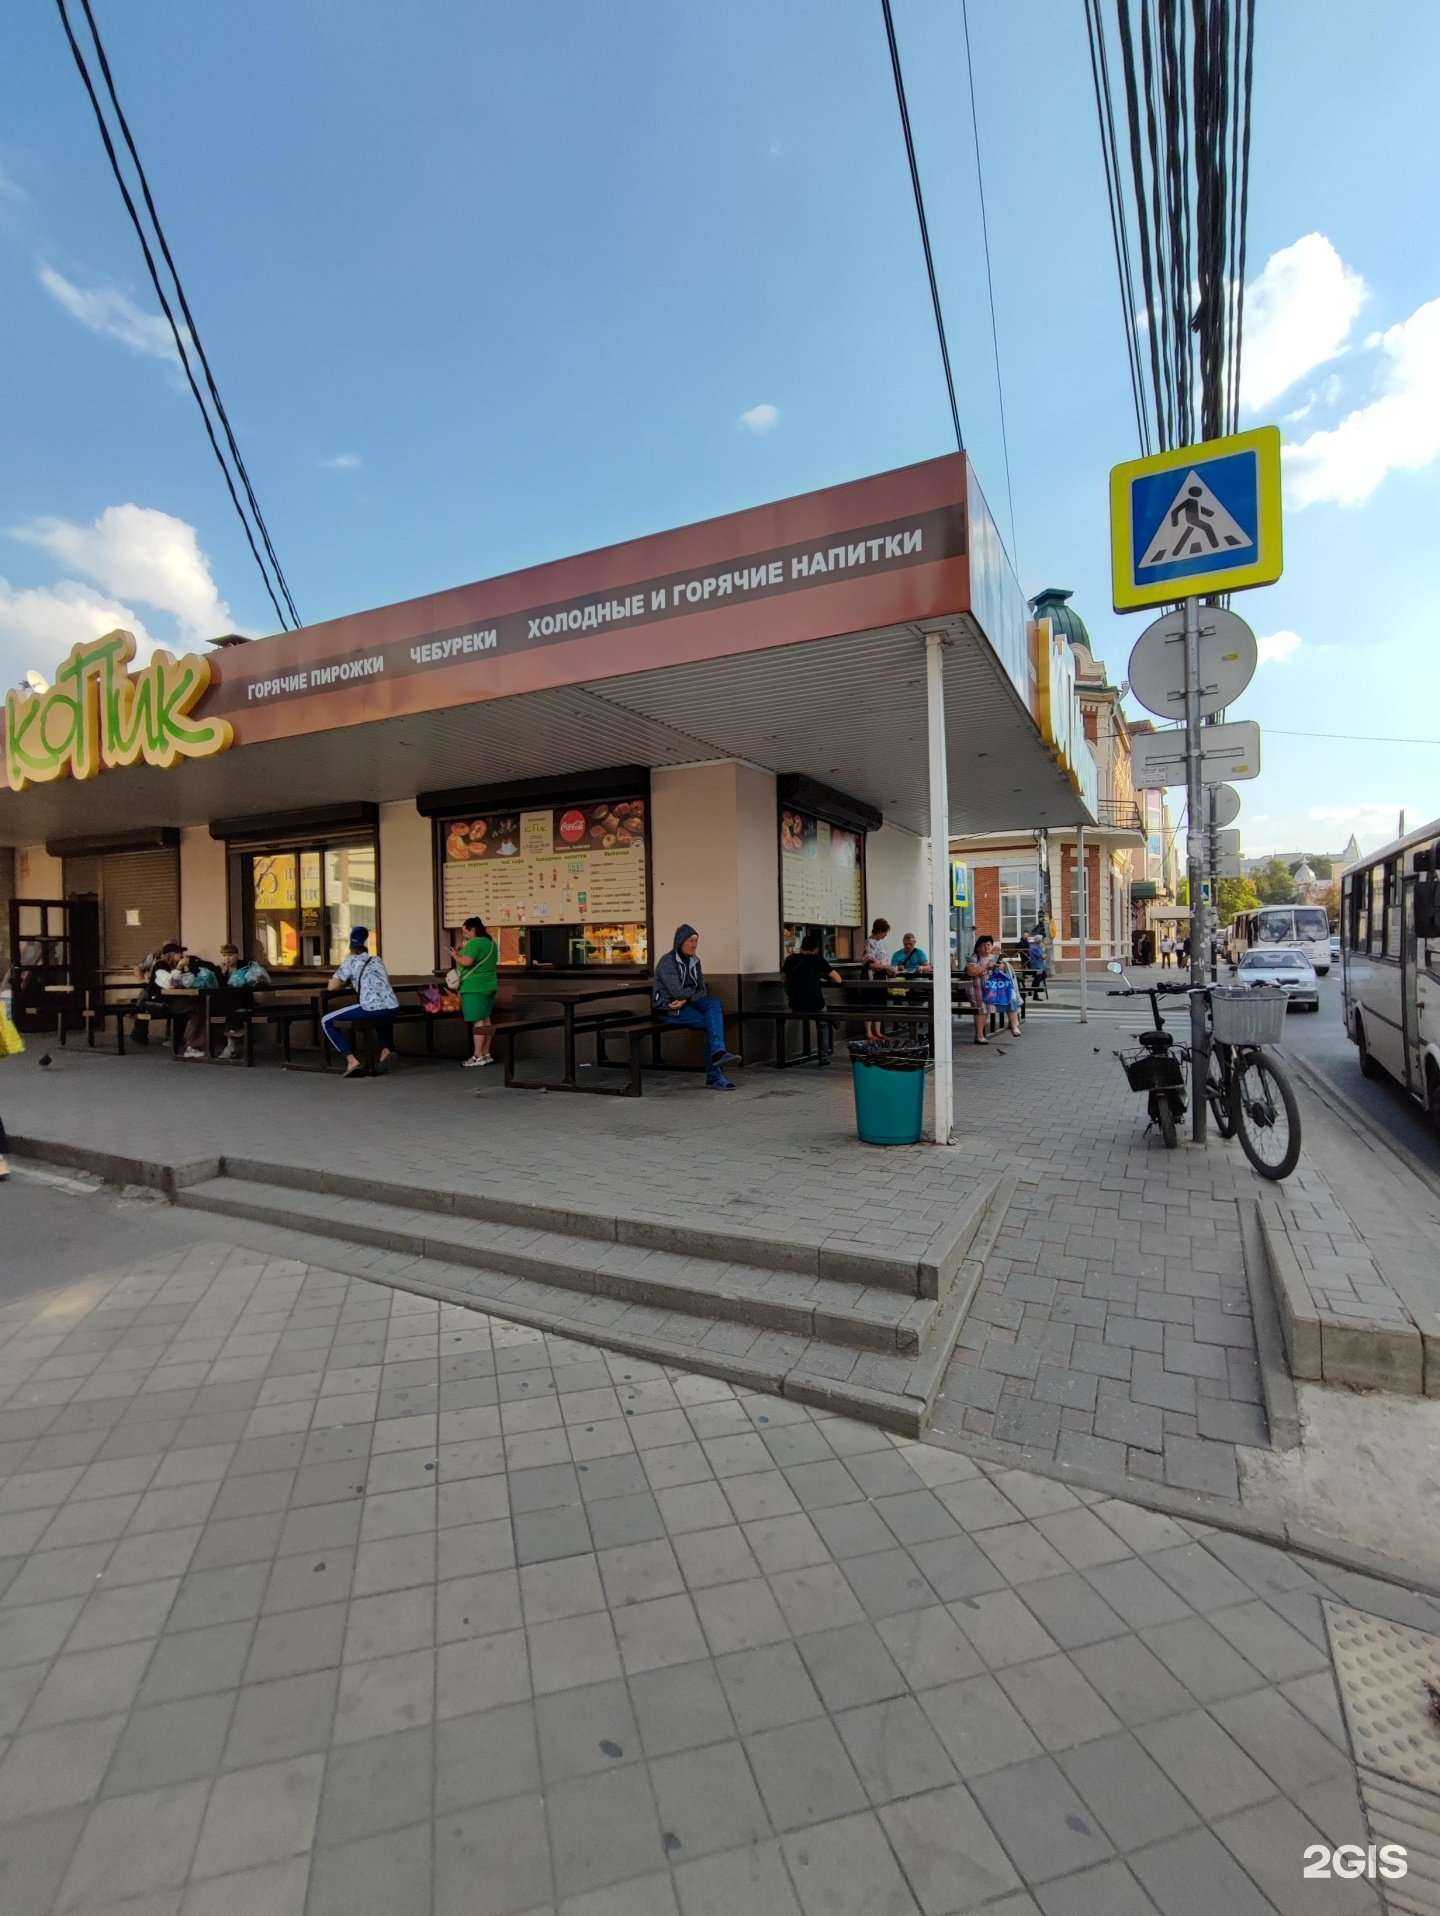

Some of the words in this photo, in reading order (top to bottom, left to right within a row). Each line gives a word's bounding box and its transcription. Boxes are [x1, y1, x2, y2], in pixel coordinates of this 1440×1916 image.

[248, 672, 307, 700] ГОРЯЧИЕ
[311, 655, 384, 686] ПИРОЖКИ
[410, 629, 498, 664] ЧЕБУРЕКИ
[527, 594, 644, 639] ХОЛОДНЫЕ
[651, 590, 666, 612] И
[673, 561, 784, 607] ГОРЯЧИЕ
[791, 529, 923, 579] НАПИТКИ
